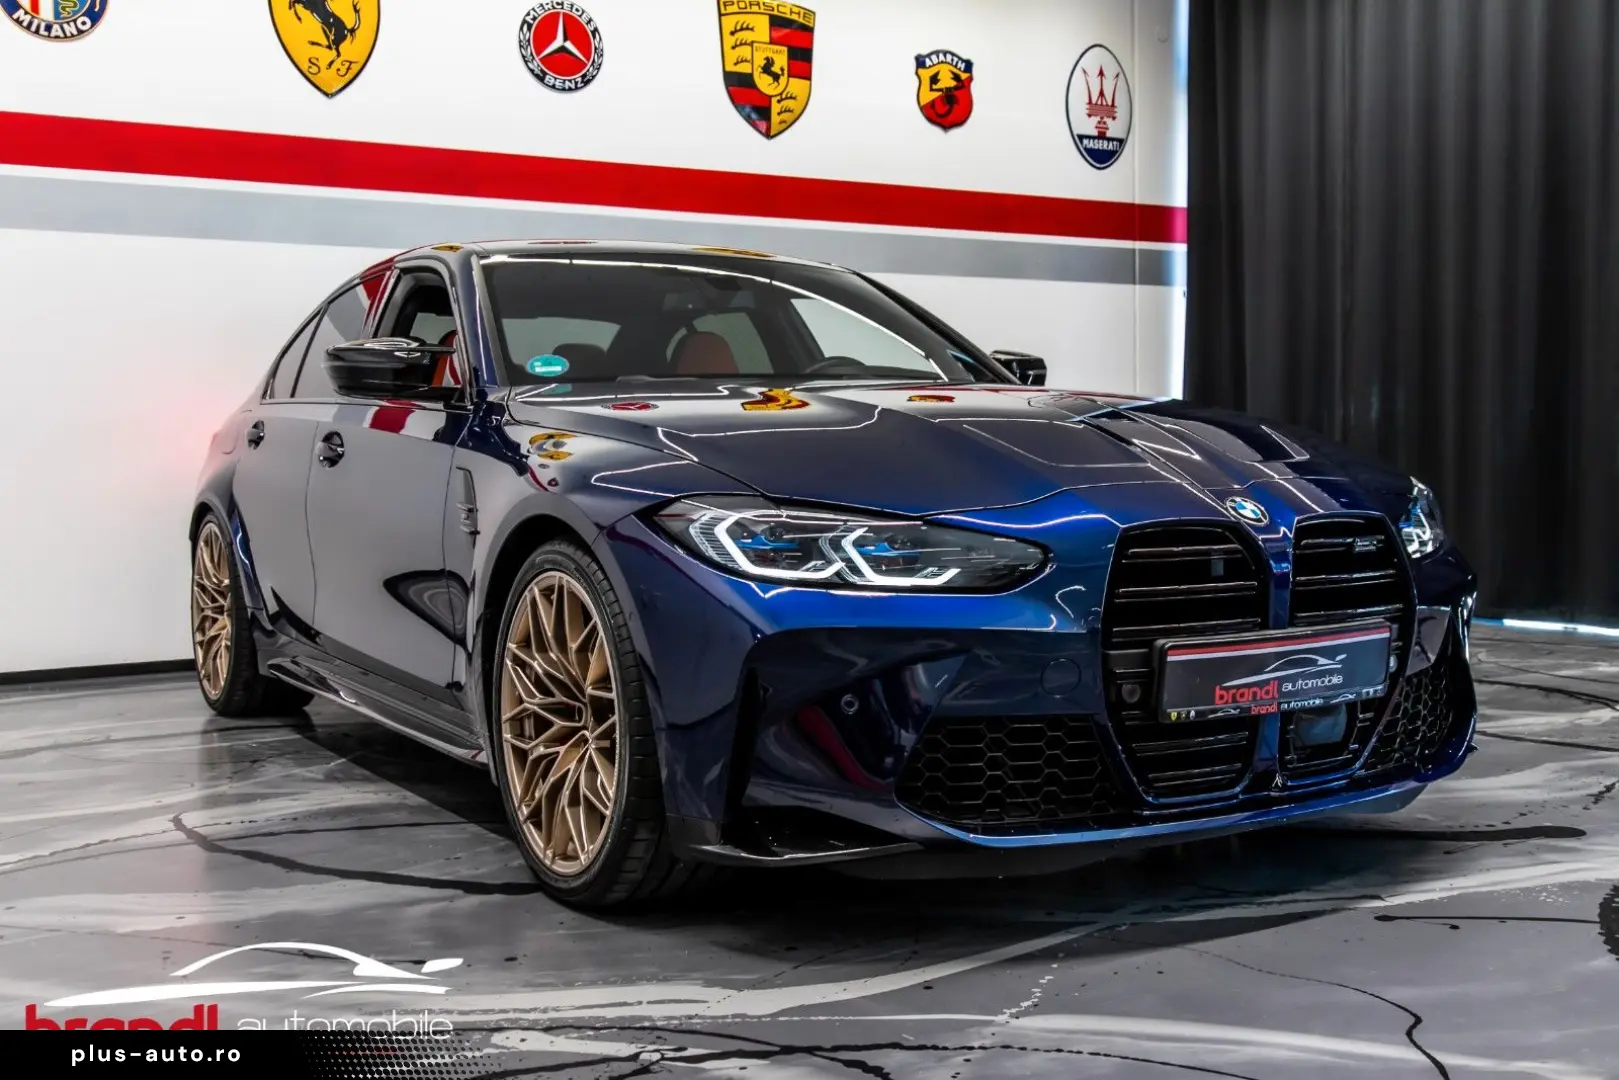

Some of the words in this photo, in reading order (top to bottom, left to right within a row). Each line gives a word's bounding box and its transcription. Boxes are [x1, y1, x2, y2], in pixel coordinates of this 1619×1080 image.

[525, 0, 597, 31] MERCEDES
[723, 0, 813, 24] PORSCHE
[11, 8, 92, 38] MILANO
[307, 56, 321, 76] S
[336, 59, 359, 77] F
[925, 52, 966, 71] ABARTH
[543, 74, 584, 90] BENZ
[1082, 138, 1120, 151] MASERATI
[1214, 680, 1279, 705] brandl
[1282, 674, 1343, 692] automobile
[1251, 701, 1278, 715] brandl
[1280, 697, 1325, 711] automobile
